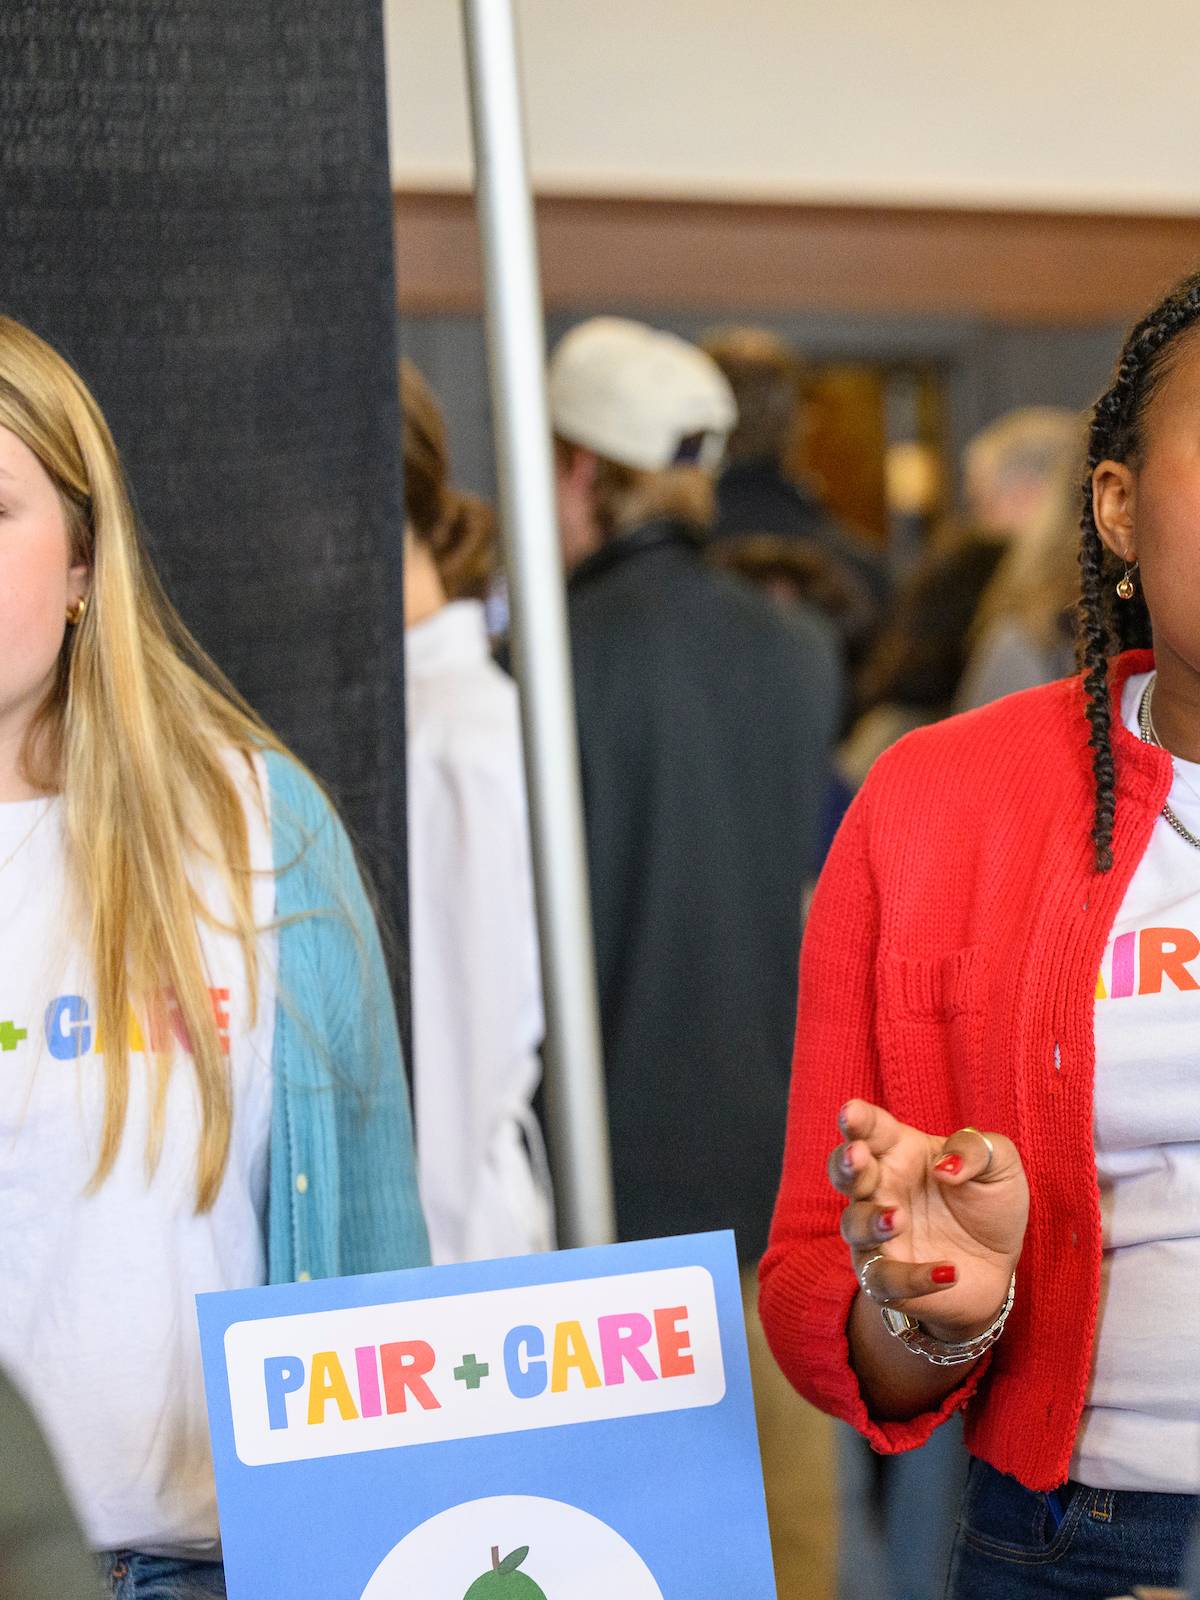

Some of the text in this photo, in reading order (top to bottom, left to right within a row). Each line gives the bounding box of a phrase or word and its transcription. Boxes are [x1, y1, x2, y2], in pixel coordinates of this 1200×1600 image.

[263, 1305, 696, 1430] PAIR + CARE
